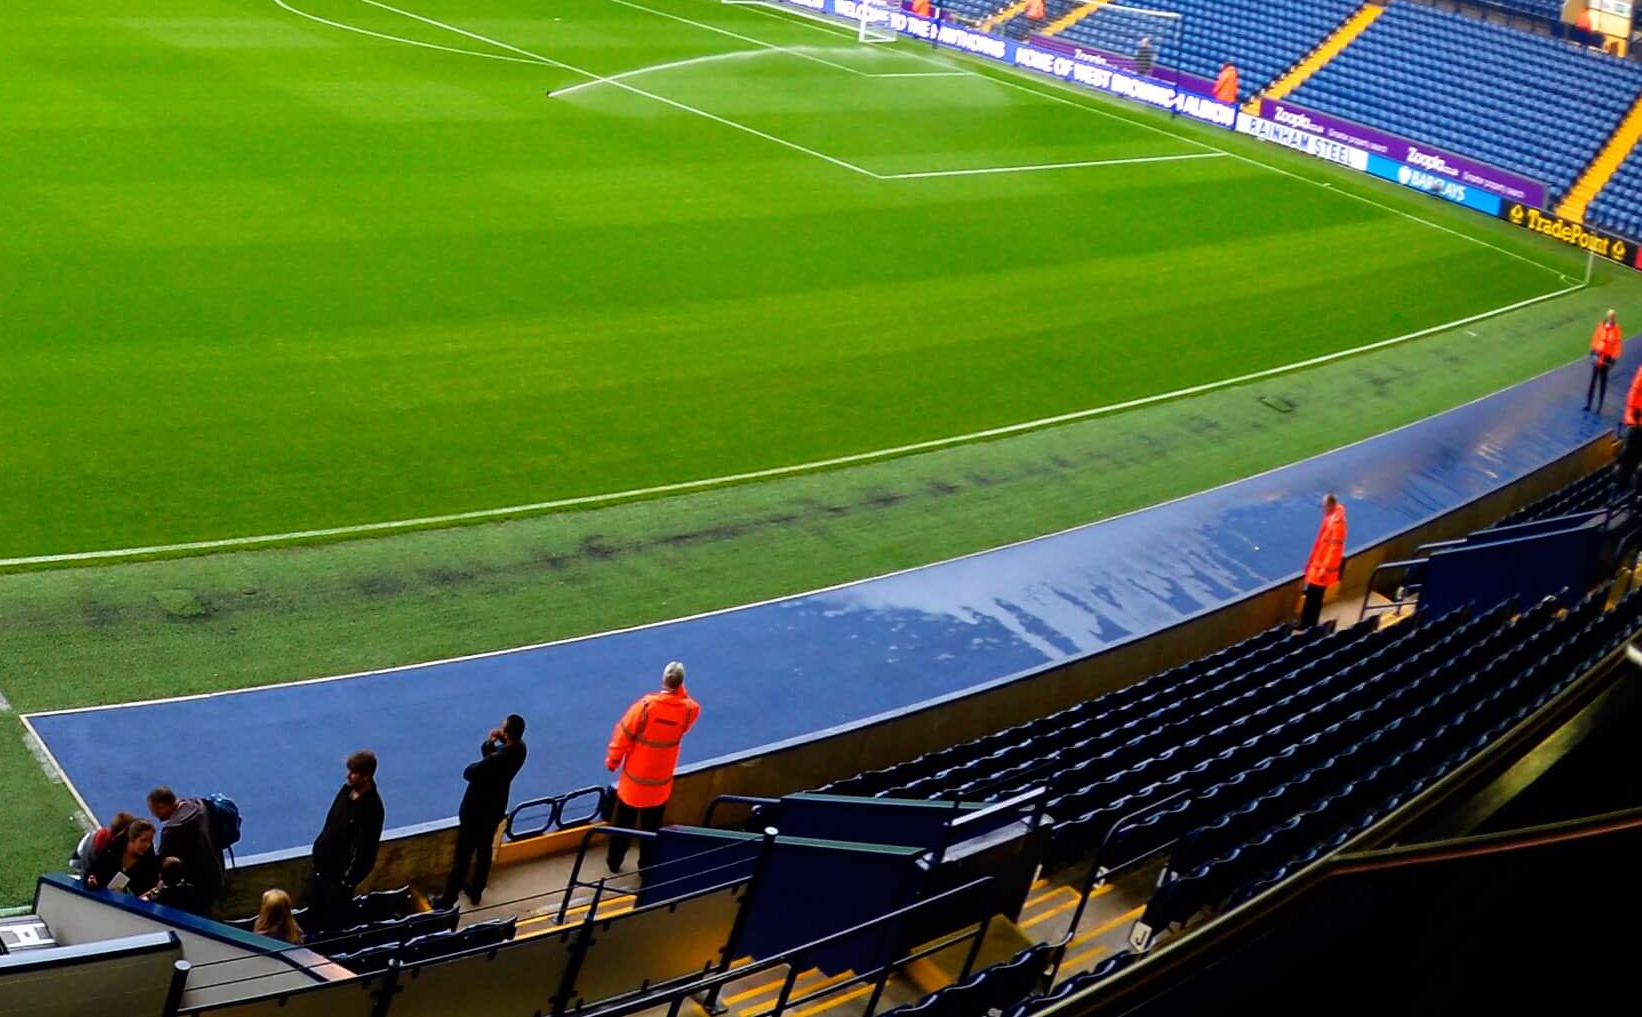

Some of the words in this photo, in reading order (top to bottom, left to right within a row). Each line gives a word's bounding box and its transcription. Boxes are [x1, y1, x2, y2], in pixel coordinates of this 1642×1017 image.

[890, 12, 908, 31] TO
[908, 16, 932, 38] THE
[1016, 47, 1055, 73] HOME
[1054, 56, 1074, 77] OF
[1074, 63, 1113, 89] WEST
[1185, 94, 1237, 126] ALBION
[1250, 118, 1310, 149] RAINHAM
[1315, 135, 1352, 165] STEEL
[1527, 207, 1609, 255] TradePoint
